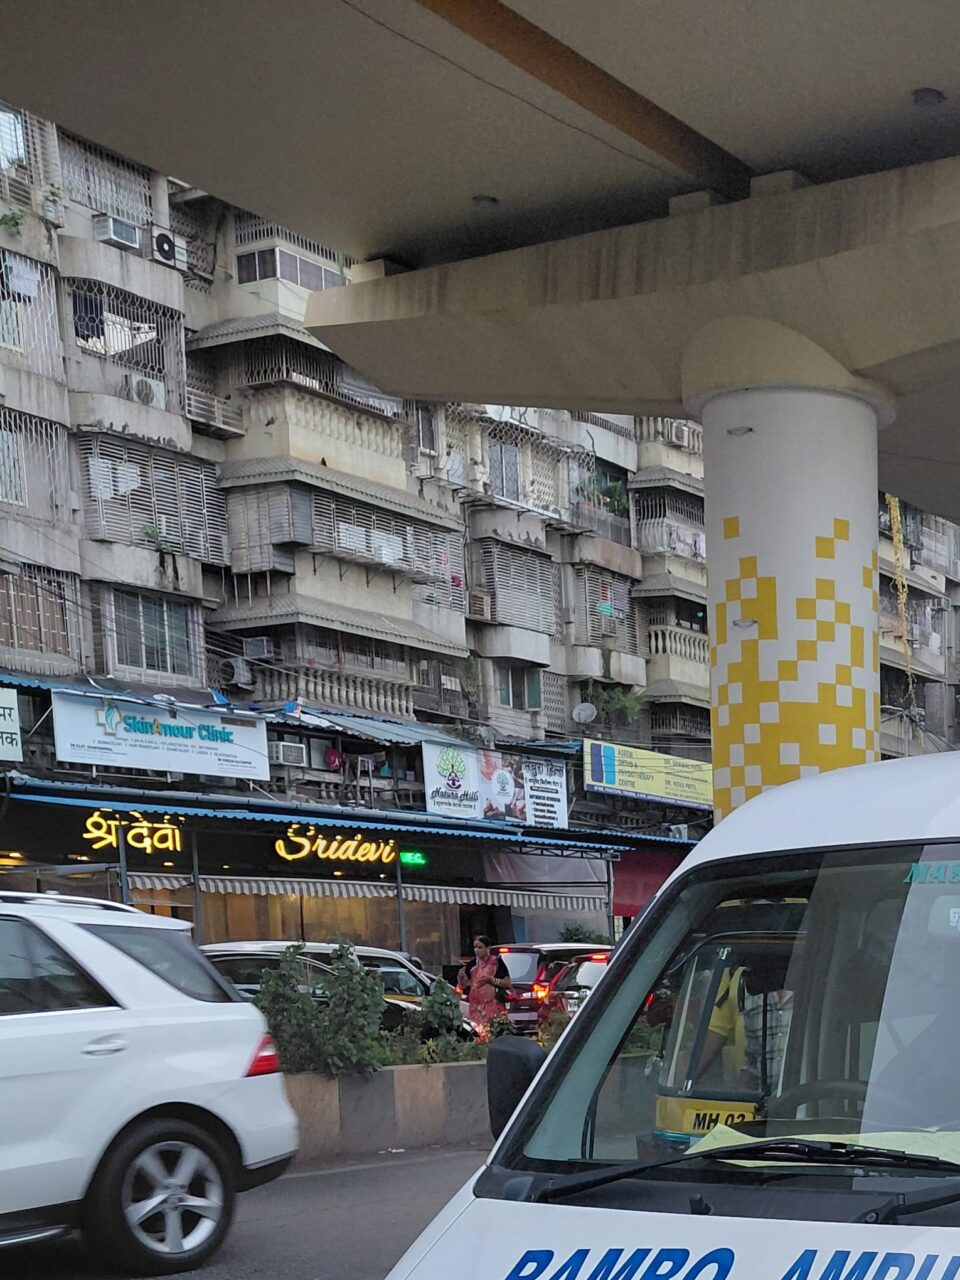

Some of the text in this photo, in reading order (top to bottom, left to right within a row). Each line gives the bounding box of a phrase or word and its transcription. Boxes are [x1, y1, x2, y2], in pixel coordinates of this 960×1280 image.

[122, 714, 197, 740] SkinAmour
[198, 724, 235, 745] Clinic
[274, 823, 396, 863] Sridevi
[693, 1112, 721, 1130] MH
